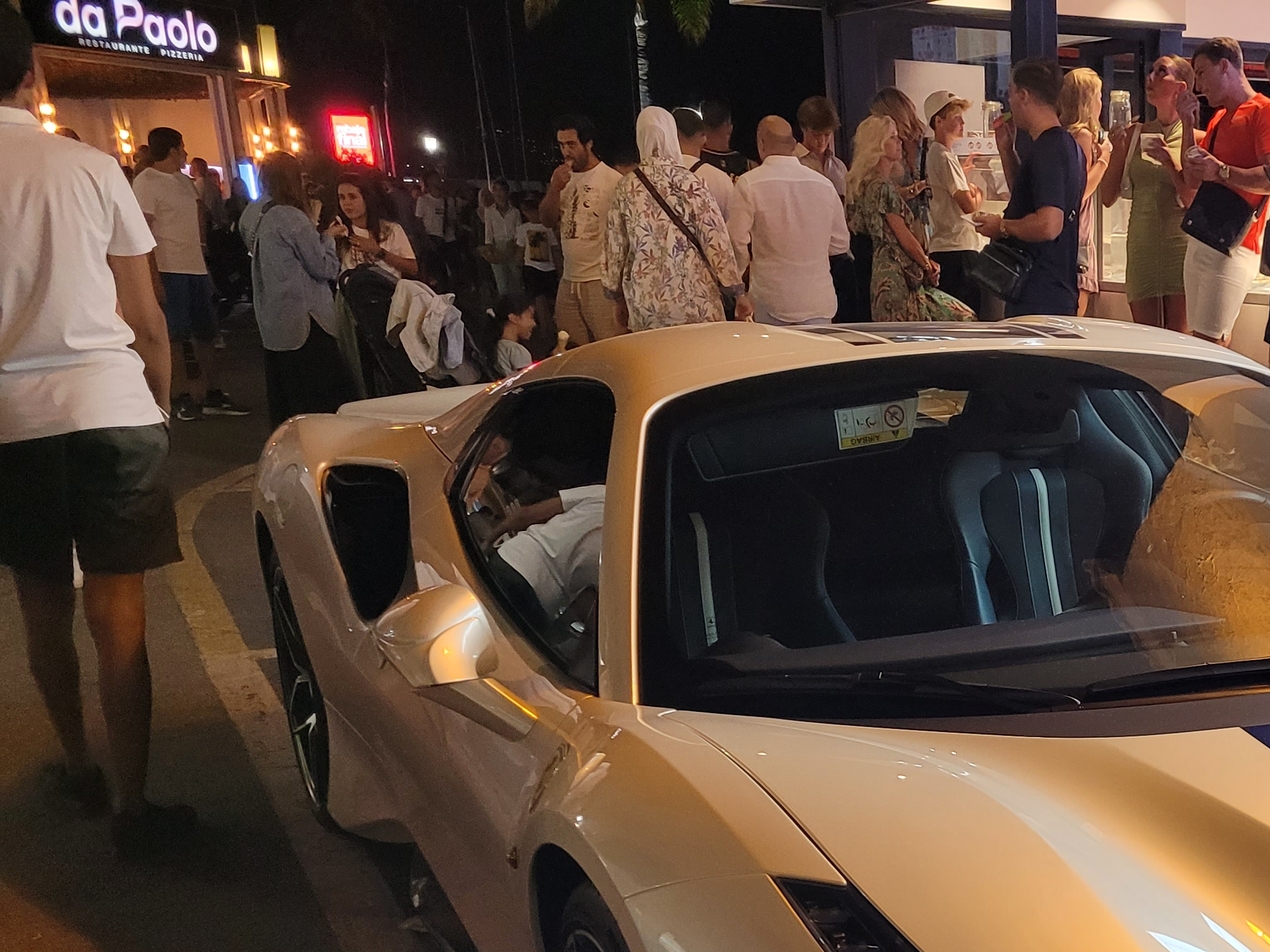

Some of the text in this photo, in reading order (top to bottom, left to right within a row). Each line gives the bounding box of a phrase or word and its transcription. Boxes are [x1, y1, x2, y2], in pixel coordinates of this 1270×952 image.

[54, 0, 218, 53] da Paolo
[78, 37, 204, 62] RESTAURANTE PIZZERIA
[850, 434, 880, 446] AIRBAG
